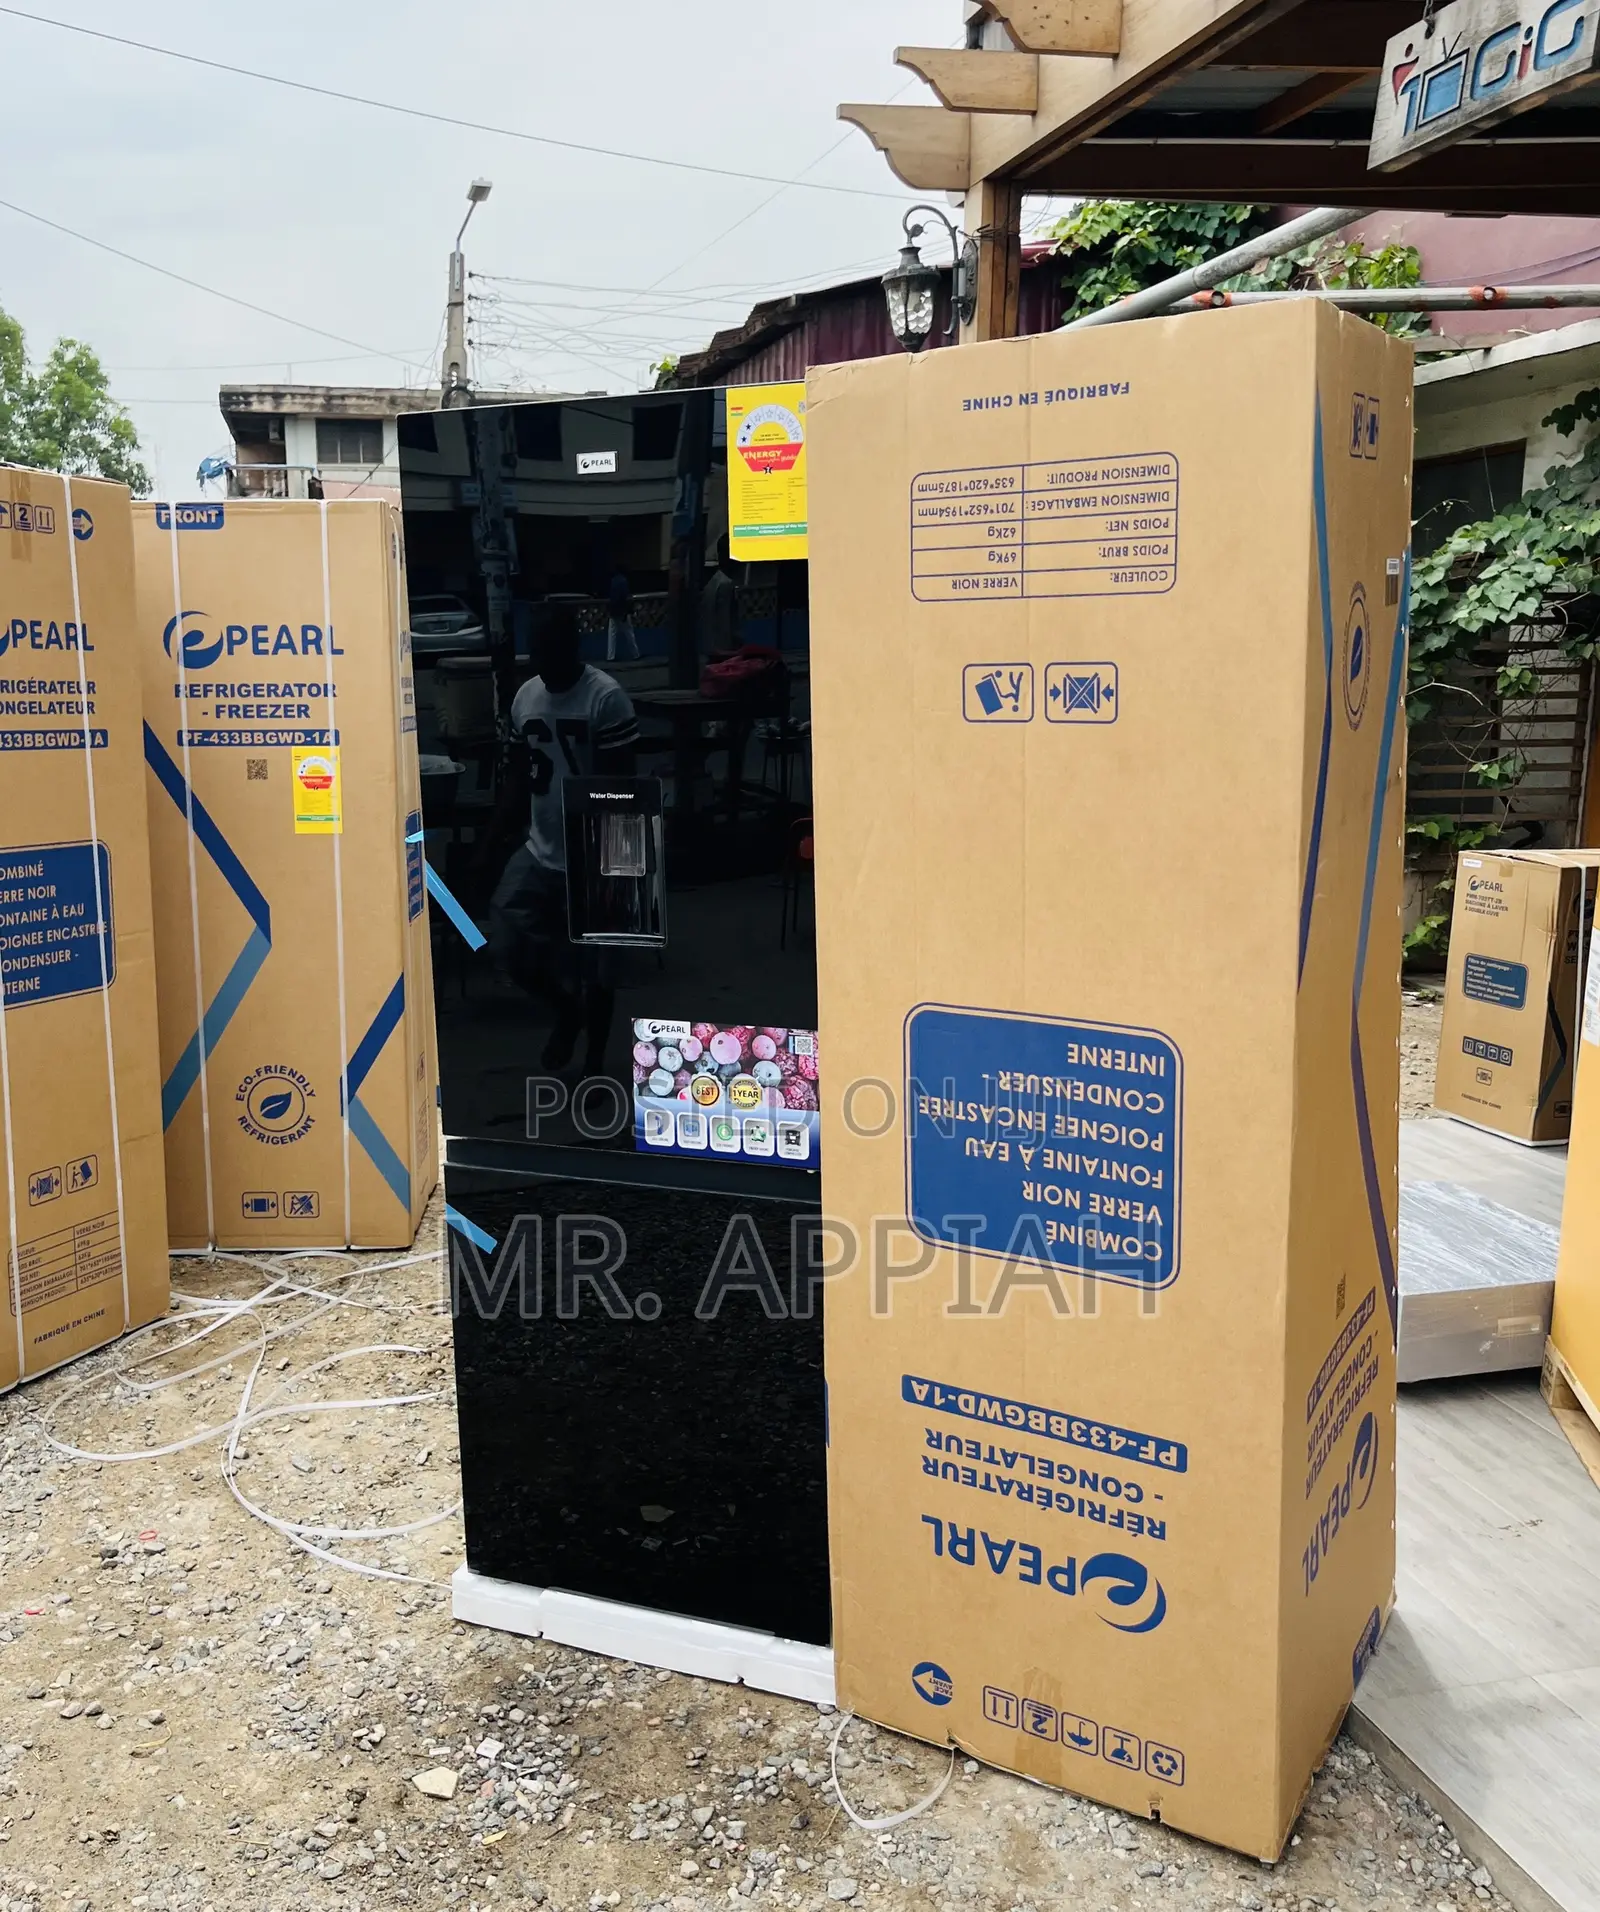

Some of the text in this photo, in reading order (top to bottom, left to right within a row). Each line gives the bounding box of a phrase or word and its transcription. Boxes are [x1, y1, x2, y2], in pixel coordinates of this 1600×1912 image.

[962, 382, 1130, 411] FABRIQUÉ EN CHINE
[743, 450, 782, 461] ENERGY
[1047, 471, 1098, 484] PRODUIT:
[1101, 464, 1170, 480] DIMENSION
[1101, 491, 1170, 506] DIMENSION
[161, 510, 219, 523] FRONT
[987, 518, 1169, 539] POIDS NET: 62Kg
[987, 544, 1169, 564] POIDS BRUT: 69Kg
[951, 570, 1168, 590] COULEUR: VERRE NOIR
[11, 618, 94, 651] PEARL
[226, 624, 344, 656] PEARL
[0, 677, 97, 695] RIGÉRATEUR
[174, 683, 337, 699] REFRIGERATOR
[215, 704, 311, 719] FREEZER
[182, 731, 332, 745] PF-433BBGWD-1A
[0, 860, 44, 880] OMBINÉ
[28, 885, 57, 899] NOIR
[1480, 880, 1504, 892] PEARL
[51, 903, 59, 919] À
[63, 903, 84, 918] EAU
[0, 933, 43, 951] OIGNEE
[2, 949, 71, 973] ONDENSUER
[661, 1025, 686, 1034] PEARL
[1067, 1043, 1165, 1077] INTERNE
[235, 1065, 316, 1102] ECO-FRIENDLY
[696, 1086, 714, 1096] BEST
[998, 1070, 1165, 1114] CONDENSUER
[238, 1115, 315, 1145] REFRIGERANT
[919, 1095, 1164, 1152] POIGNEE ENCASTRÉE
[965, 1137, 1163, 1189] FONTAINE À EAU
[1022, 1180, 1163, 1226] VERRE NOIR
[1046, 1220, 1163, 1262] COMBINÉ
[83, 1308, 105, 1323] CHINE
[1307, 1334, 1372, 1463] CONGELATEUR
[909, 1380, 1178, 1467] PF-433BBGWD-1A
[924, 1428, 1144, 1504] CONGELATEUR
[921, 1455, 1166, 1541] RÉFRIGÉRATEUR
[1302, 1462, 1350, 1598] PEARL
[921, 1514, 1076, 1596] PEARL
